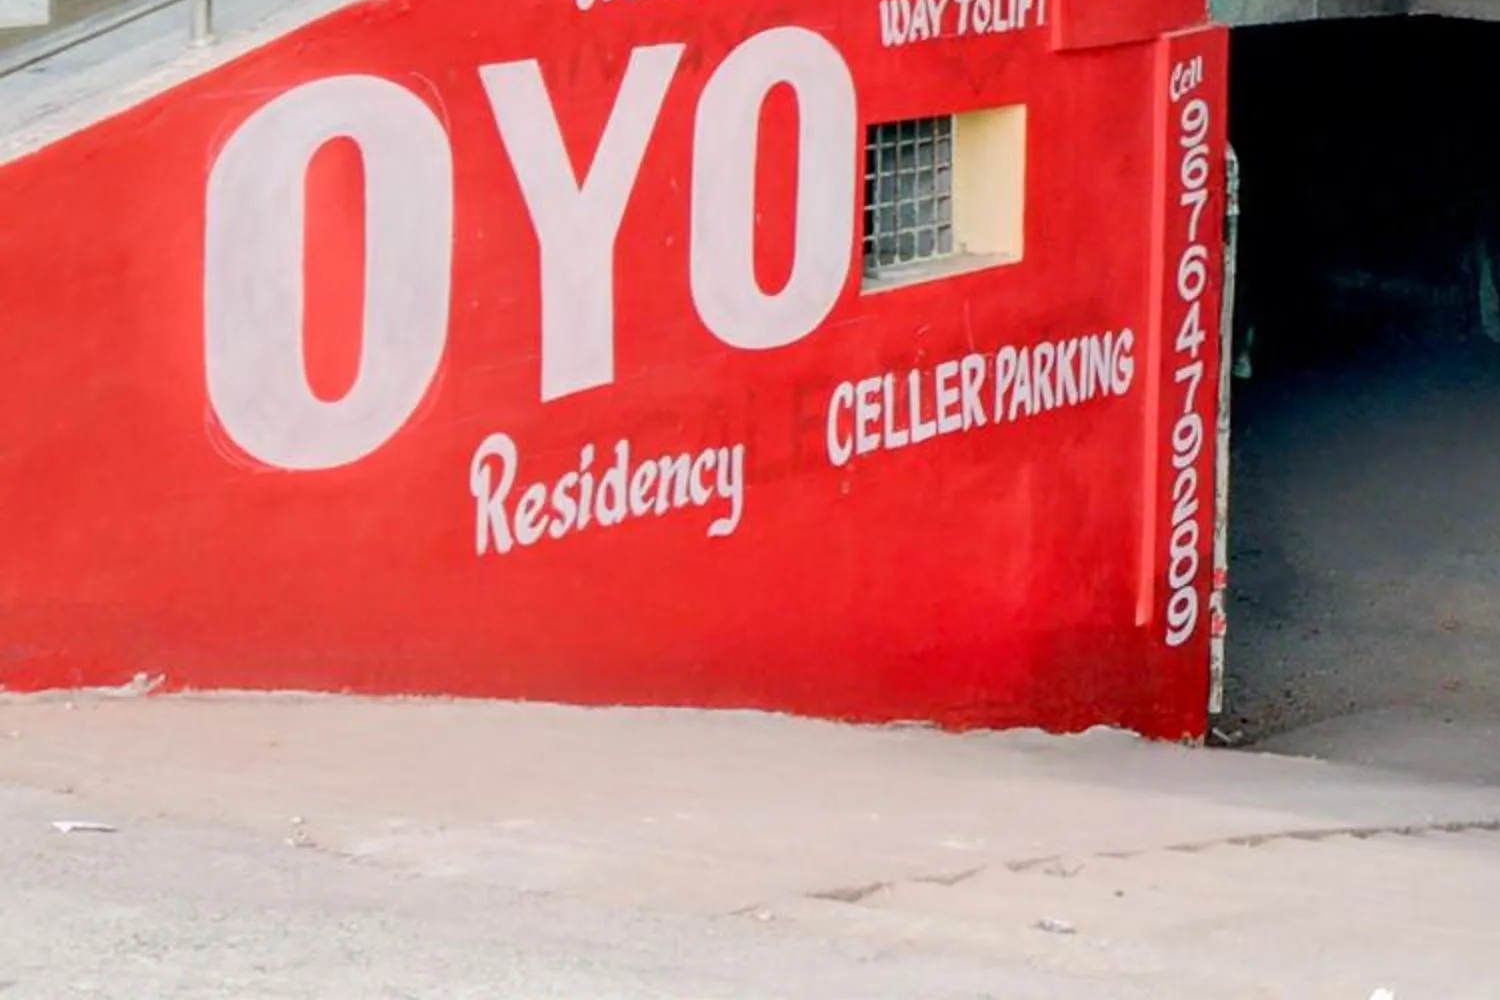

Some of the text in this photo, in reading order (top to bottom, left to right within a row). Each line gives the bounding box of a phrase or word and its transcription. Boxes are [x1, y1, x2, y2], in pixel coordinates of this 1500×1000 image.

[206, 26, 857, 470] OYO
[1165, 55, 1209, 647] Cell 9676479289
[470, 432, 745, 557] Residency
[827, 327, 1135, 468] CELLER PARKING
